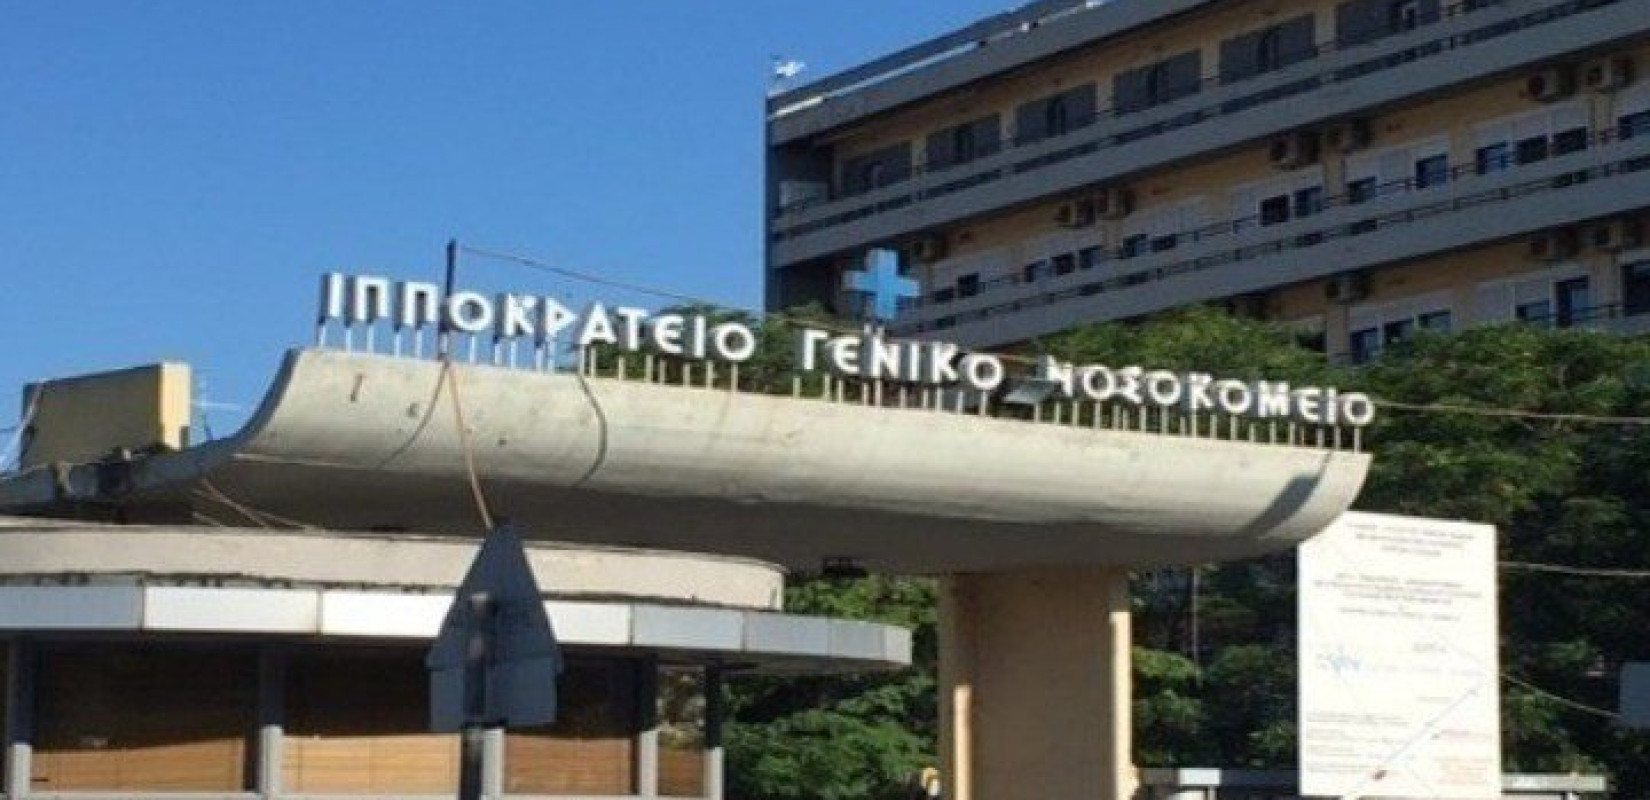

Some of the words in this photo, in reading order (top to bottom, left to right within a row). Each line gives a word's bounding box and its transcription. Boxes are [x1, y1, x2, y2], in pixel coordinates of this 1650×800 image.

[325, 272, 756, 361] ΙΠΠΟΚΡΑΤΕΙΟ
[801, 328, 1004, 391] ΓΕΝΙΚΟ
[1045, 354, 1376, 425] ΝΟΣΟΚΟΜΕΙΟ
